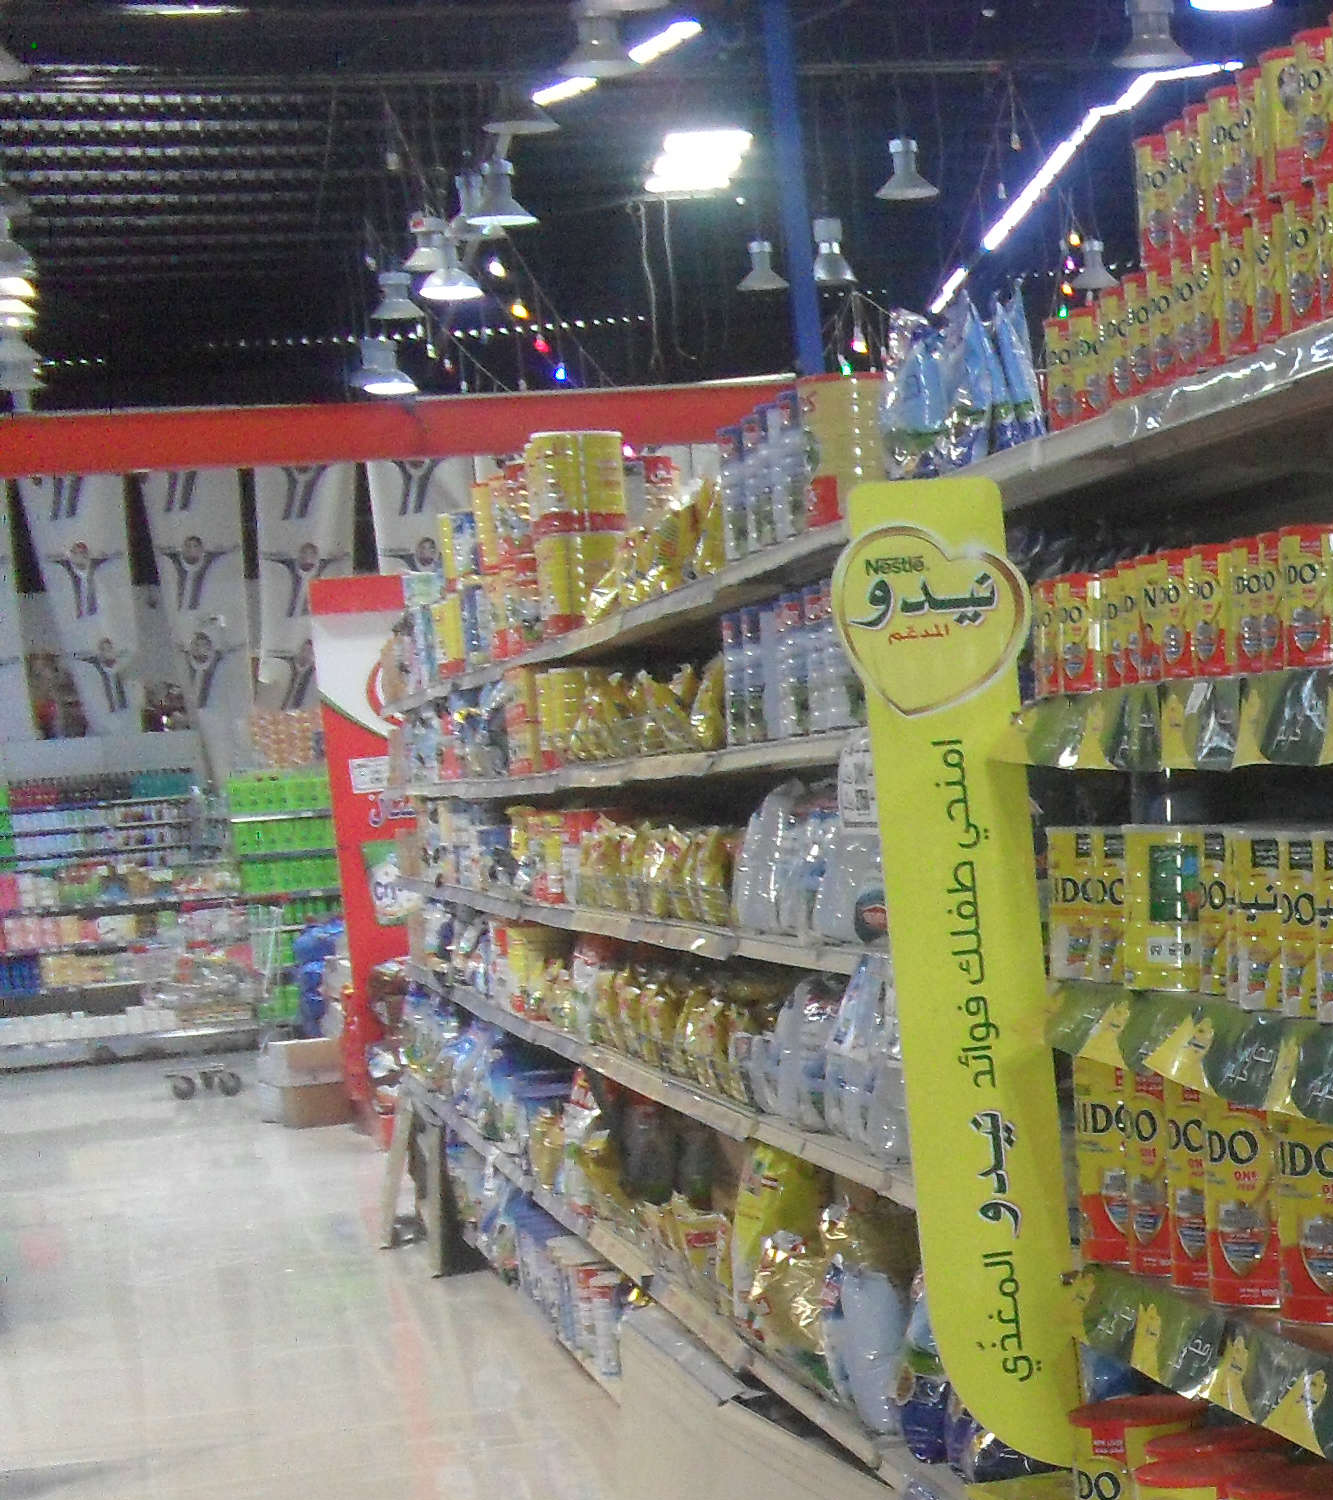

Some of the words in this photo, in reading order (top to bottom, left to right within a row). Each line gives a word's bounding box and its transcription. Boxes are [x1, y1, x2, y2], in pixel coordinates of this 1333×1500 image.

[851, 571, 996, 628] نيدو
[933, 739, 990, 847] امنحي
[950, 860, 984, 986] طفلك
[957, 995, 1000, 1090] فوائد
[971, 1110, 1016, 1239] نيدو
